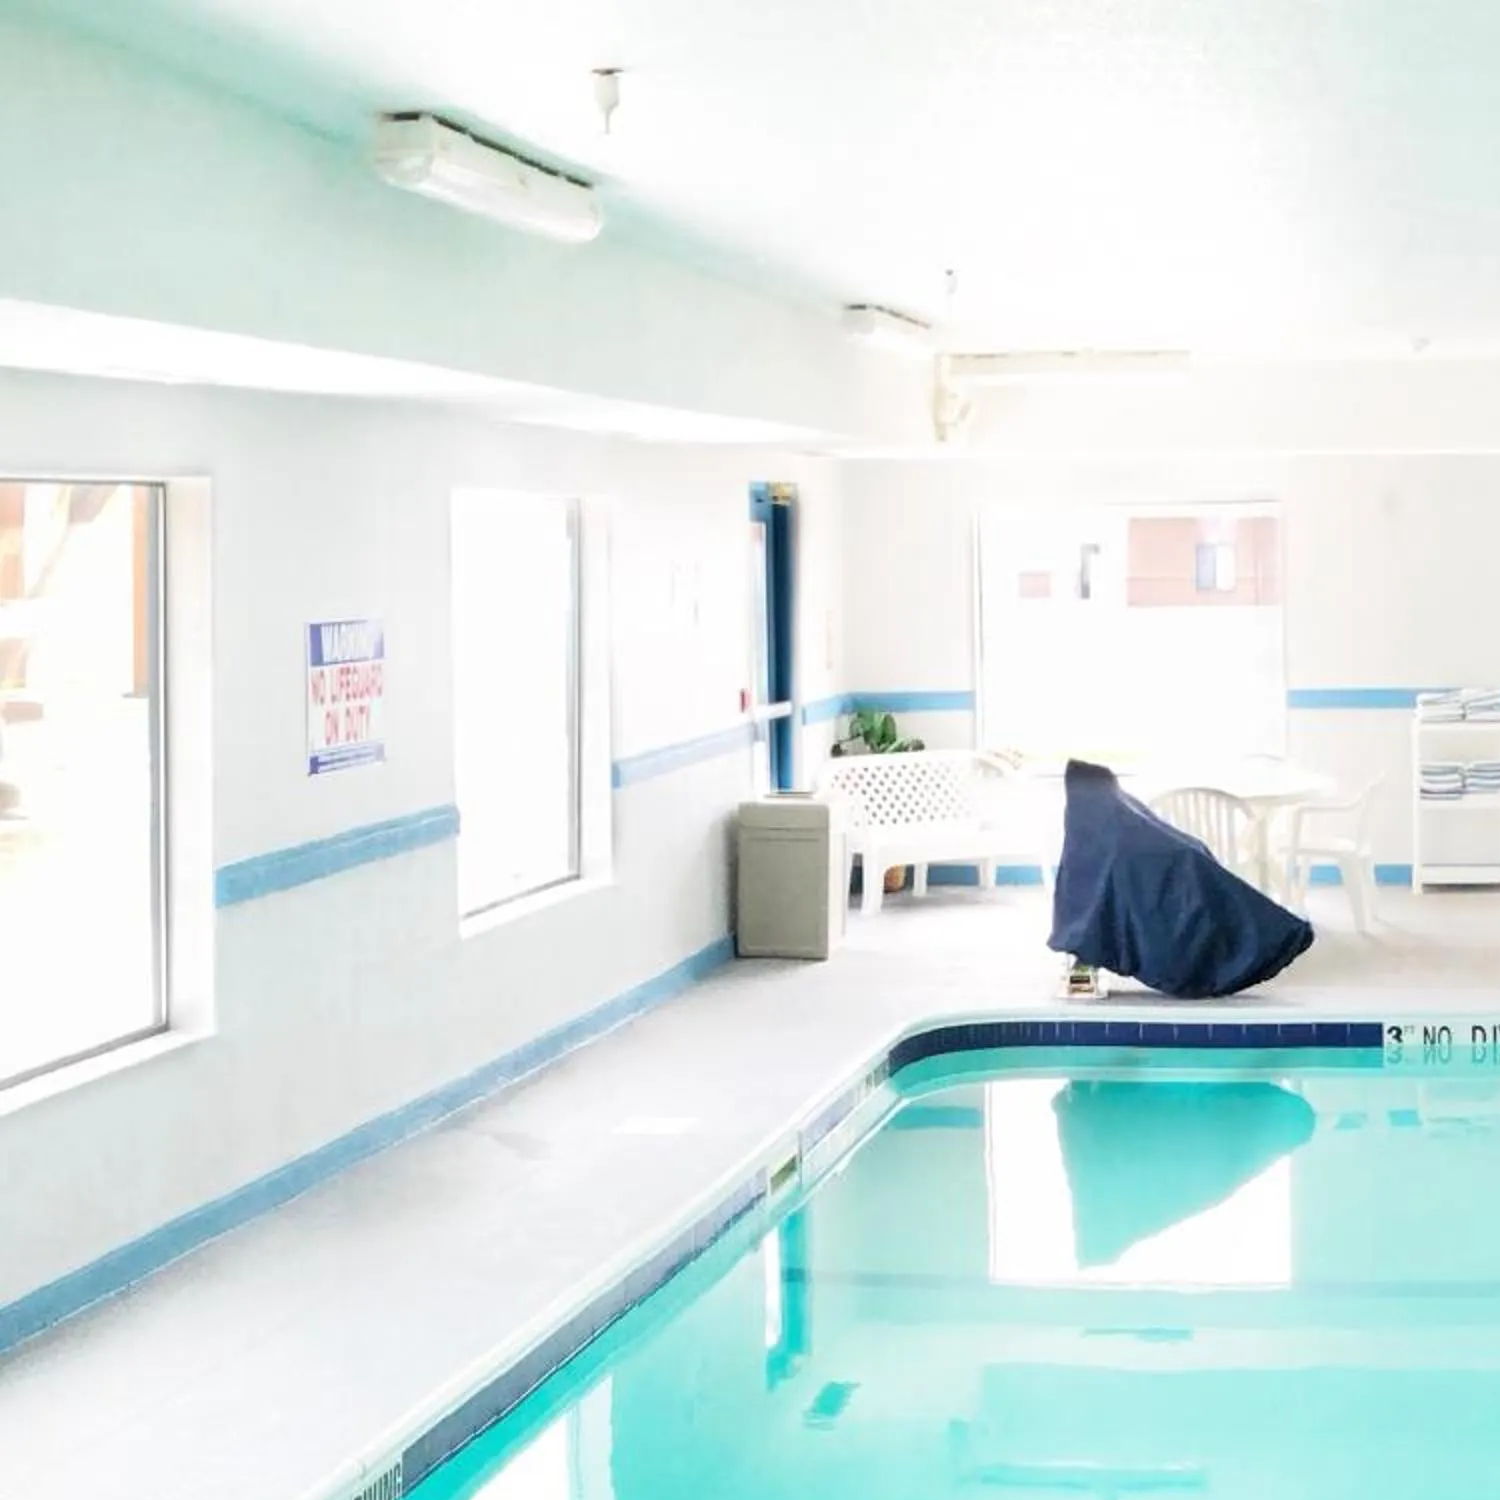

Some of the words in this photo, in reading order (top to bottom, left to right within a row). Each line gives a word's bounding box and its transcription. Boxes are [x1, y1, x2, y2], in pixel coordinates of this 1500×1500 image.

[311, 669, 325, 704] NO
[330, 664, 383, 702] LIFEGUARD
[324, 711, 339, 745] ON
[345, 705, 370, 742] DUTY
[1423, 1025, 1452, 1044] NO
